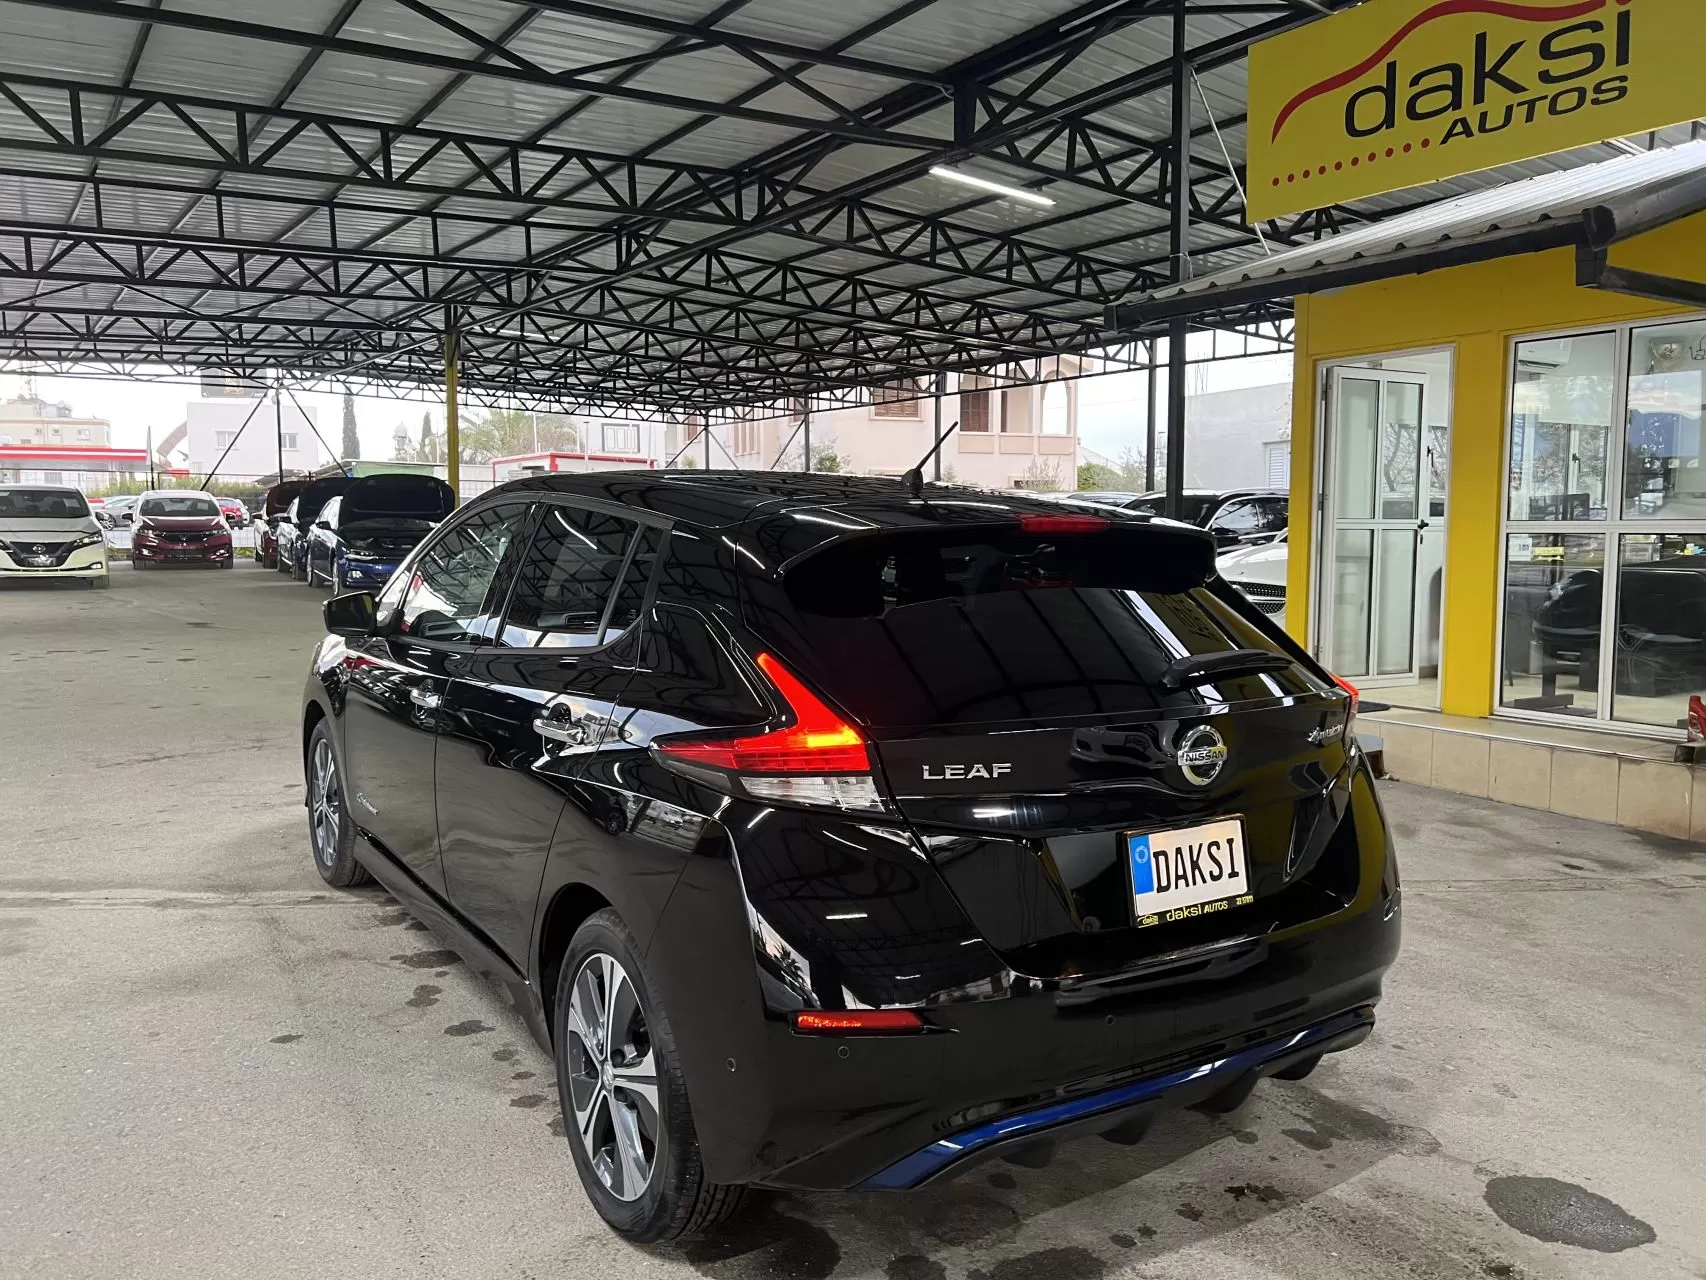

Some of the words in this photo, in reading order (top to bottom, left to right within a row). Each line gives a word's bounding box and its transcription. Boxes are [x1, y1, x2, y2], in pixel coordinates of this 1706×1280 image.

[1344, 0, 1632, 138] daksi
[1439, 74, 1629, 146] AUTOS
[922, 763, 1012, 780] LEAF
[1185, 750, 1224, 762] NISSAN
[1152, 837, 1240, 894] DAKSI
[1166, 904, 1202, 921] daksi
[1203, 901, 1229, 913] AUTOS
